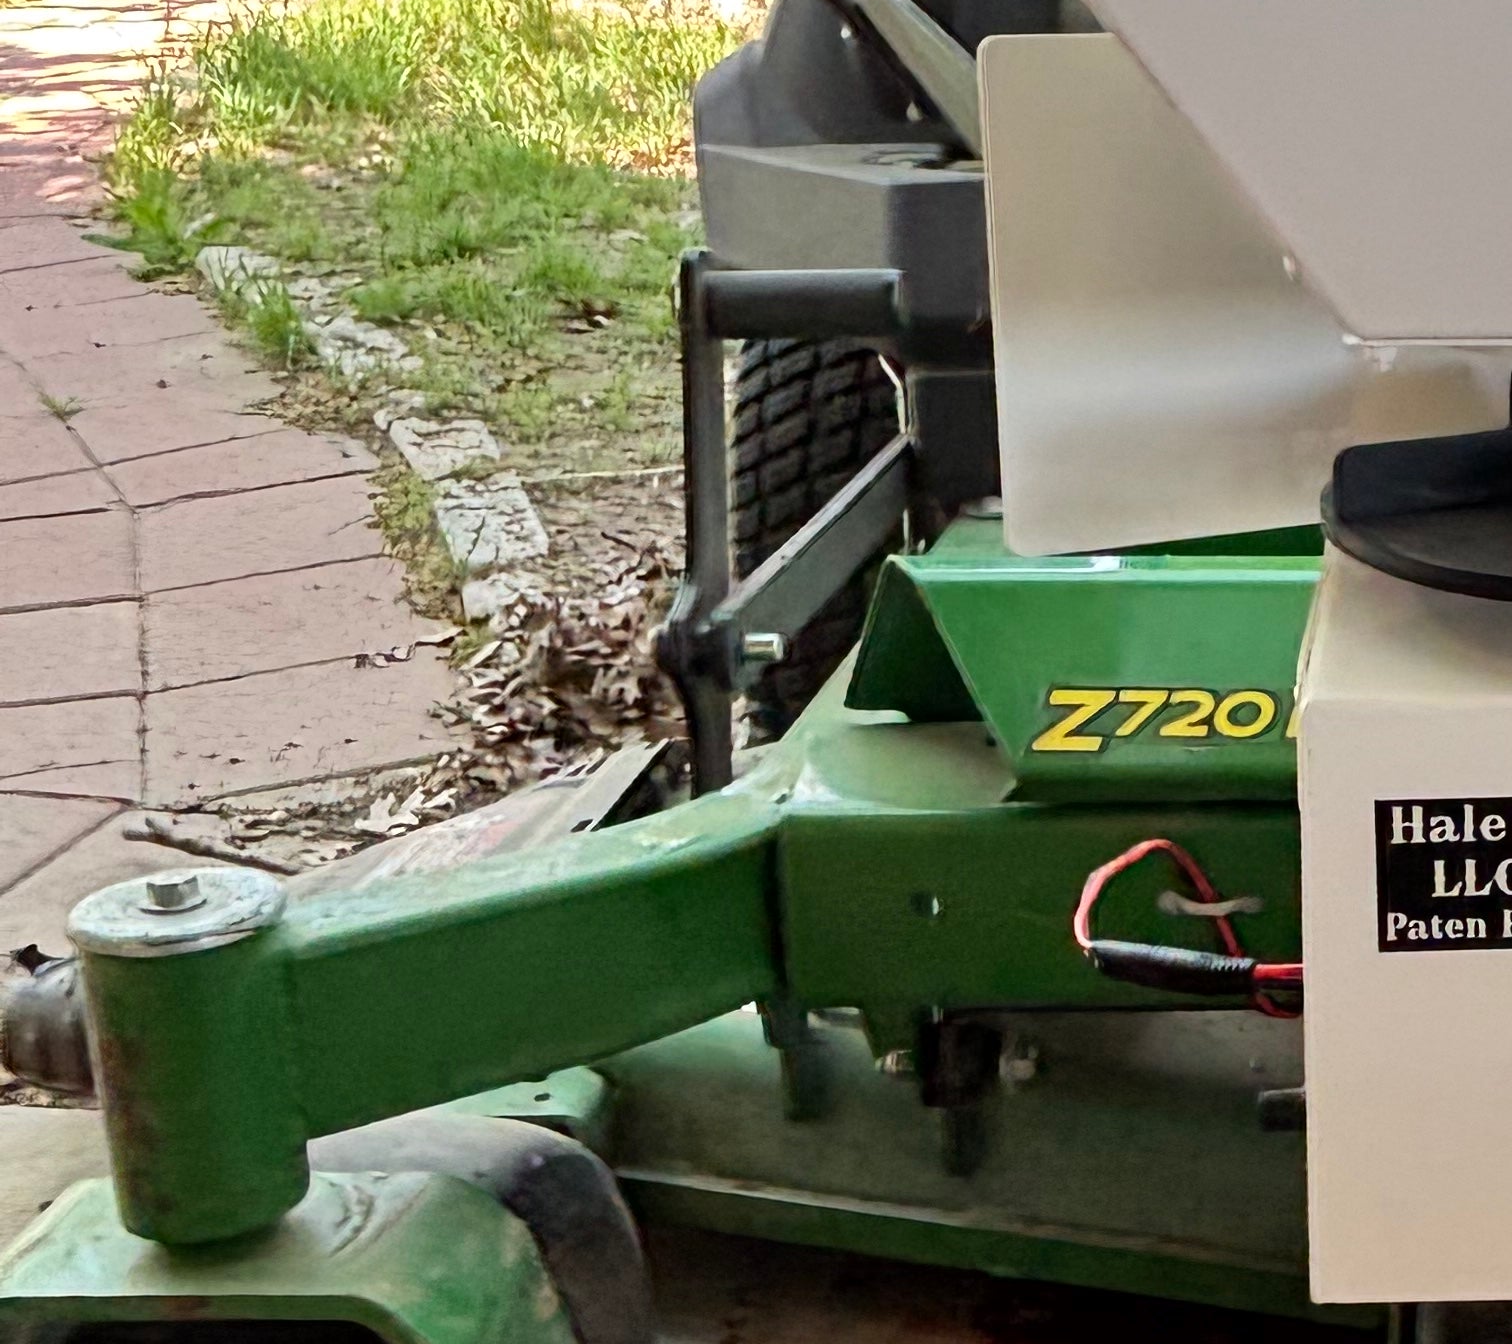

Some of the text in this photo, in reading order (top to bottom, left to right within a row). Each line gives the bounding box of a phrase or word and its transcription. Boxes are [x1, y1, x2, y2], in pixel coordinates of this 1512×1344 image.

[1031, 688, 1300, 752] Z720
[1390, 803, 1507, 845] Hale
[1386, 912, 1487, 942] Paten
